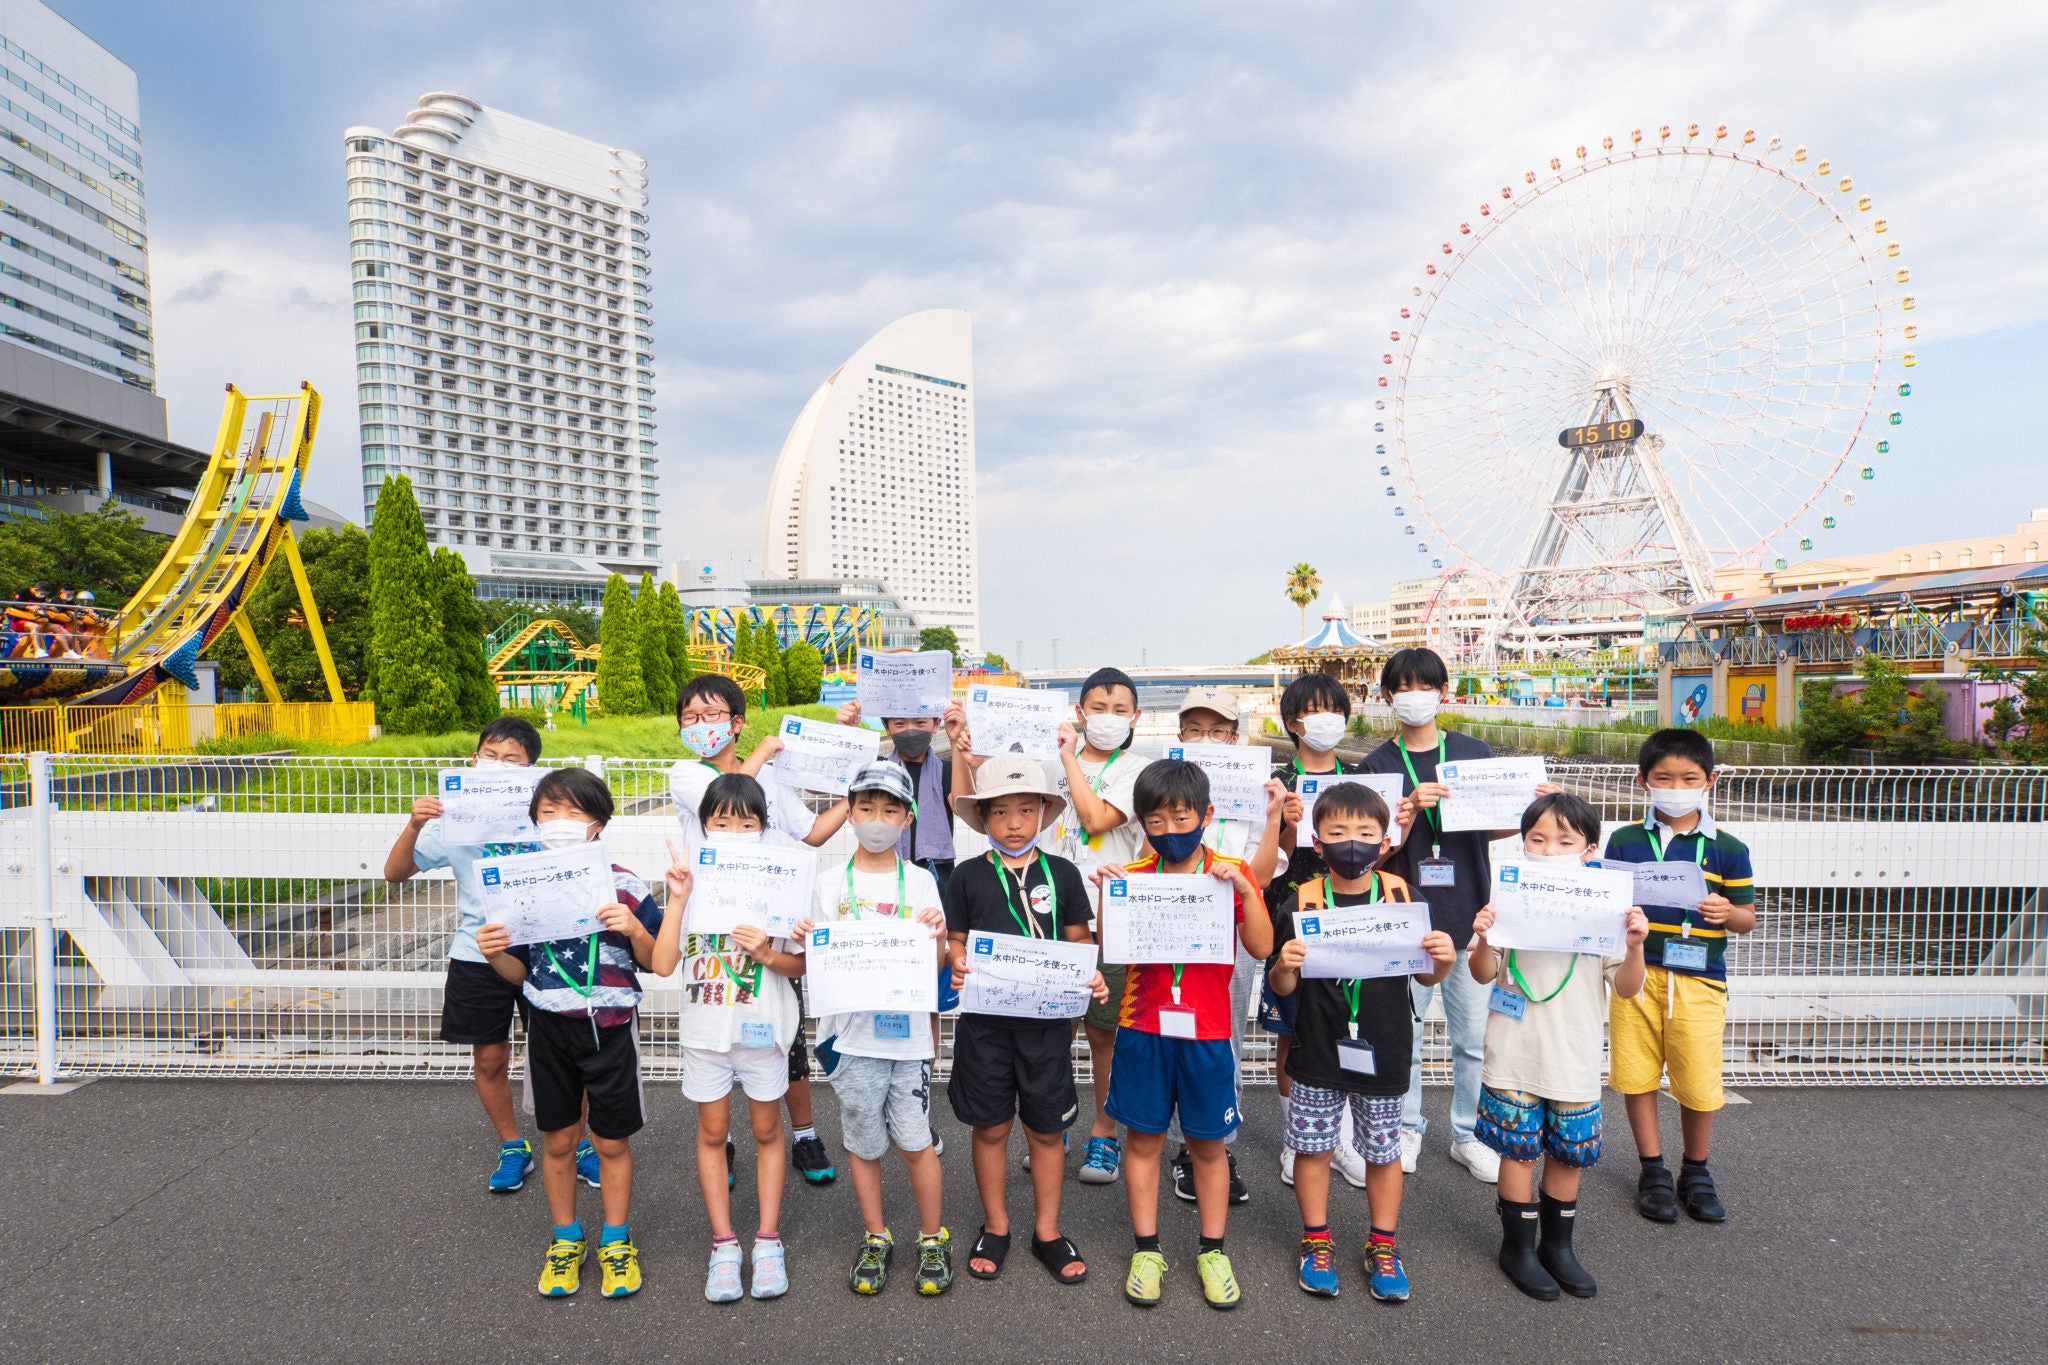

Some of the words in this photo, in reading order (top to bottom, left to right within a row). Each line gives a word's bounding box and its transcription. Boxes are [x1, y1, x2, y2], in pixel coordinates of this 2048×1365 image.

[1575, 426, 1598, 444] 15
[1608, 422, 1631, 440] 19
[874, 668, 936, 676] 水中ドローンを使って
[987, 701, 1053, 712] 水中ドローンを使って
[800, 735, 864, 751] 水中ドローンを使って
[1460, 772, 1530, 782] 水中ドローンを使って
[463, 785, 536, 795] 水中ドローンを使って
[717, 862, 797, 876] 水中ドローンを使って
[503, 867, 590, 889] 水中ドローンを使って
[1520, 882, 1610, 899] 水中ドローンを使って
[1128, 894, 1213, 904] 水中ドローンを使って
[1323, 920, 1409, 938] 水中ドローンを使って
[831, 938, 916, 950] 水中ドローンを使って
[993, 954, 1077, 971] 水中ドローンを使って
